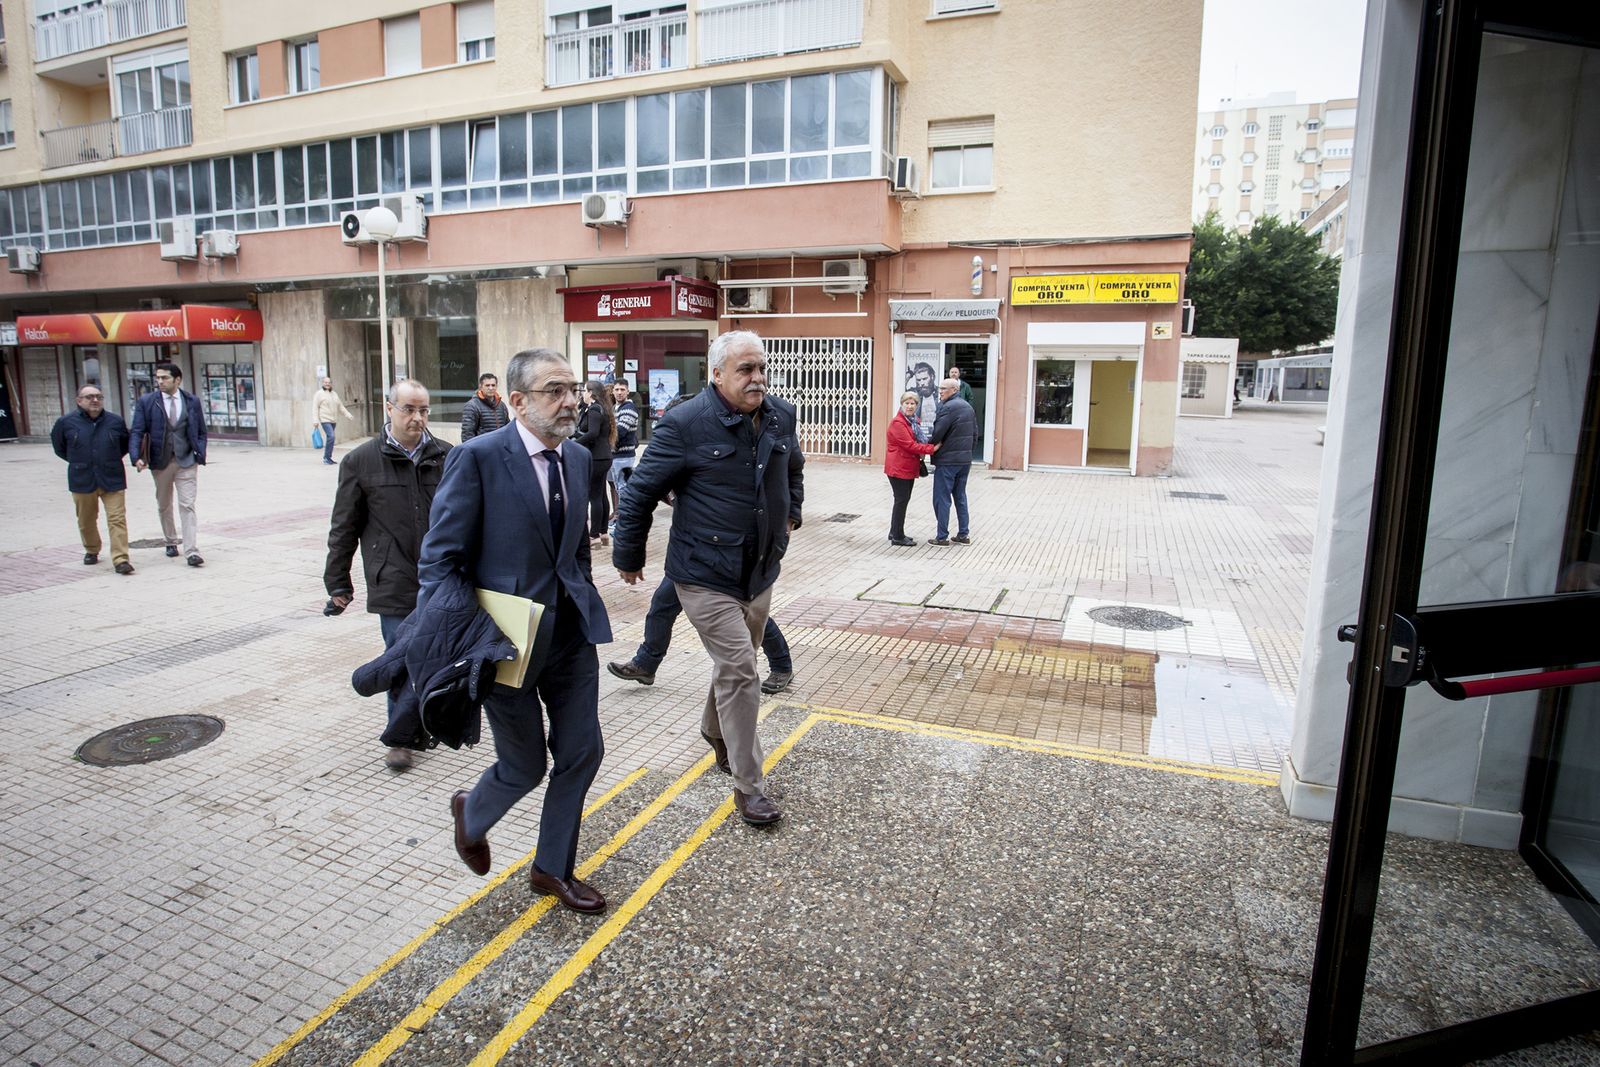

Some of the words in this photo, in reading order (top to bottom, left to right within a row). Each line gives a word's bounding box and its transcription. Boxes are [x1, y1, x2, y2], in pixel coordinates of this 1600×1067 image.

[1100, 282, 1137, 290] COMPRA
[1037, 291, 1064, 299] ORO
[1121, 290, 1150, 298] ORO
[612, 296, 651, 308] GENERALI
[688, 293, 714, 308] GENERALI
[611, 309, 631, 317] Seguros
[895, 303, 917, 316] Luis
[920, 303, 953, 317] Castro
[955, 309, 997, 317] PELUQUERO
